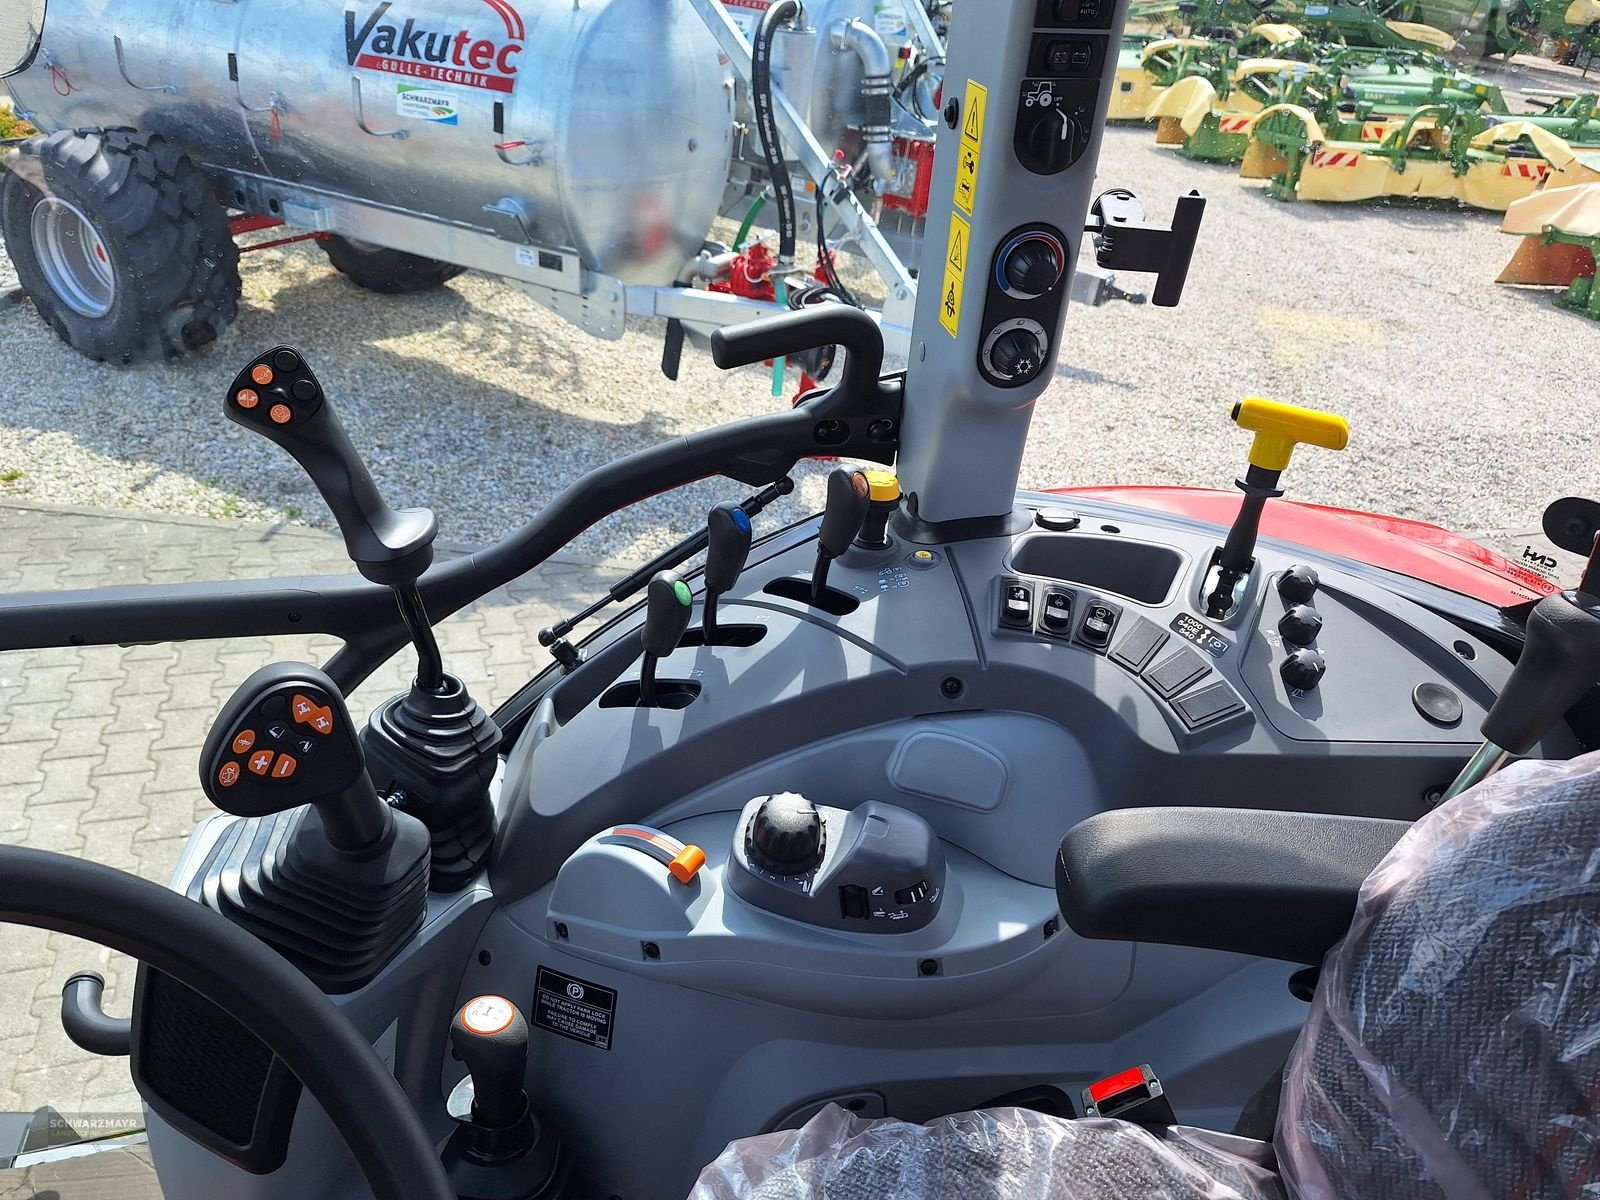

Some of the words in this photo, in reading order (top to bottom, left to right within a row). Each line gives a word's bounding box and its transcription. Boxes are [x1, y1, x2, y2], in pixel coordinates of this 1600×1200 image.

[345, 1, 523, 74] Vakutec
[401, 93, 450, 107] SCHWARZMAYR
[1178, 620, 1199, 634] 540E
[1184, 616, 1203, 629] 1000
[1179, 628, 1195, 640] 540
[556, 1004, 579, 1015] TRACTOR
[585, 1014, 606, 1024] MOVING
[560, 1001, 576, 1009] APPLY
[576, 1006, 590, 1014] PARK
[590, 1010, 606, 1019] LOCK
[547, 1010, 567, 1019] FAILURE
[575, 1019, 596, 1029] COMPLY
[556, 1018, 574, 1027] CAUSE
[574, 1024, 596, 1034] DAMAGE
[568, 1027, 591, 1037] VEHICLE
